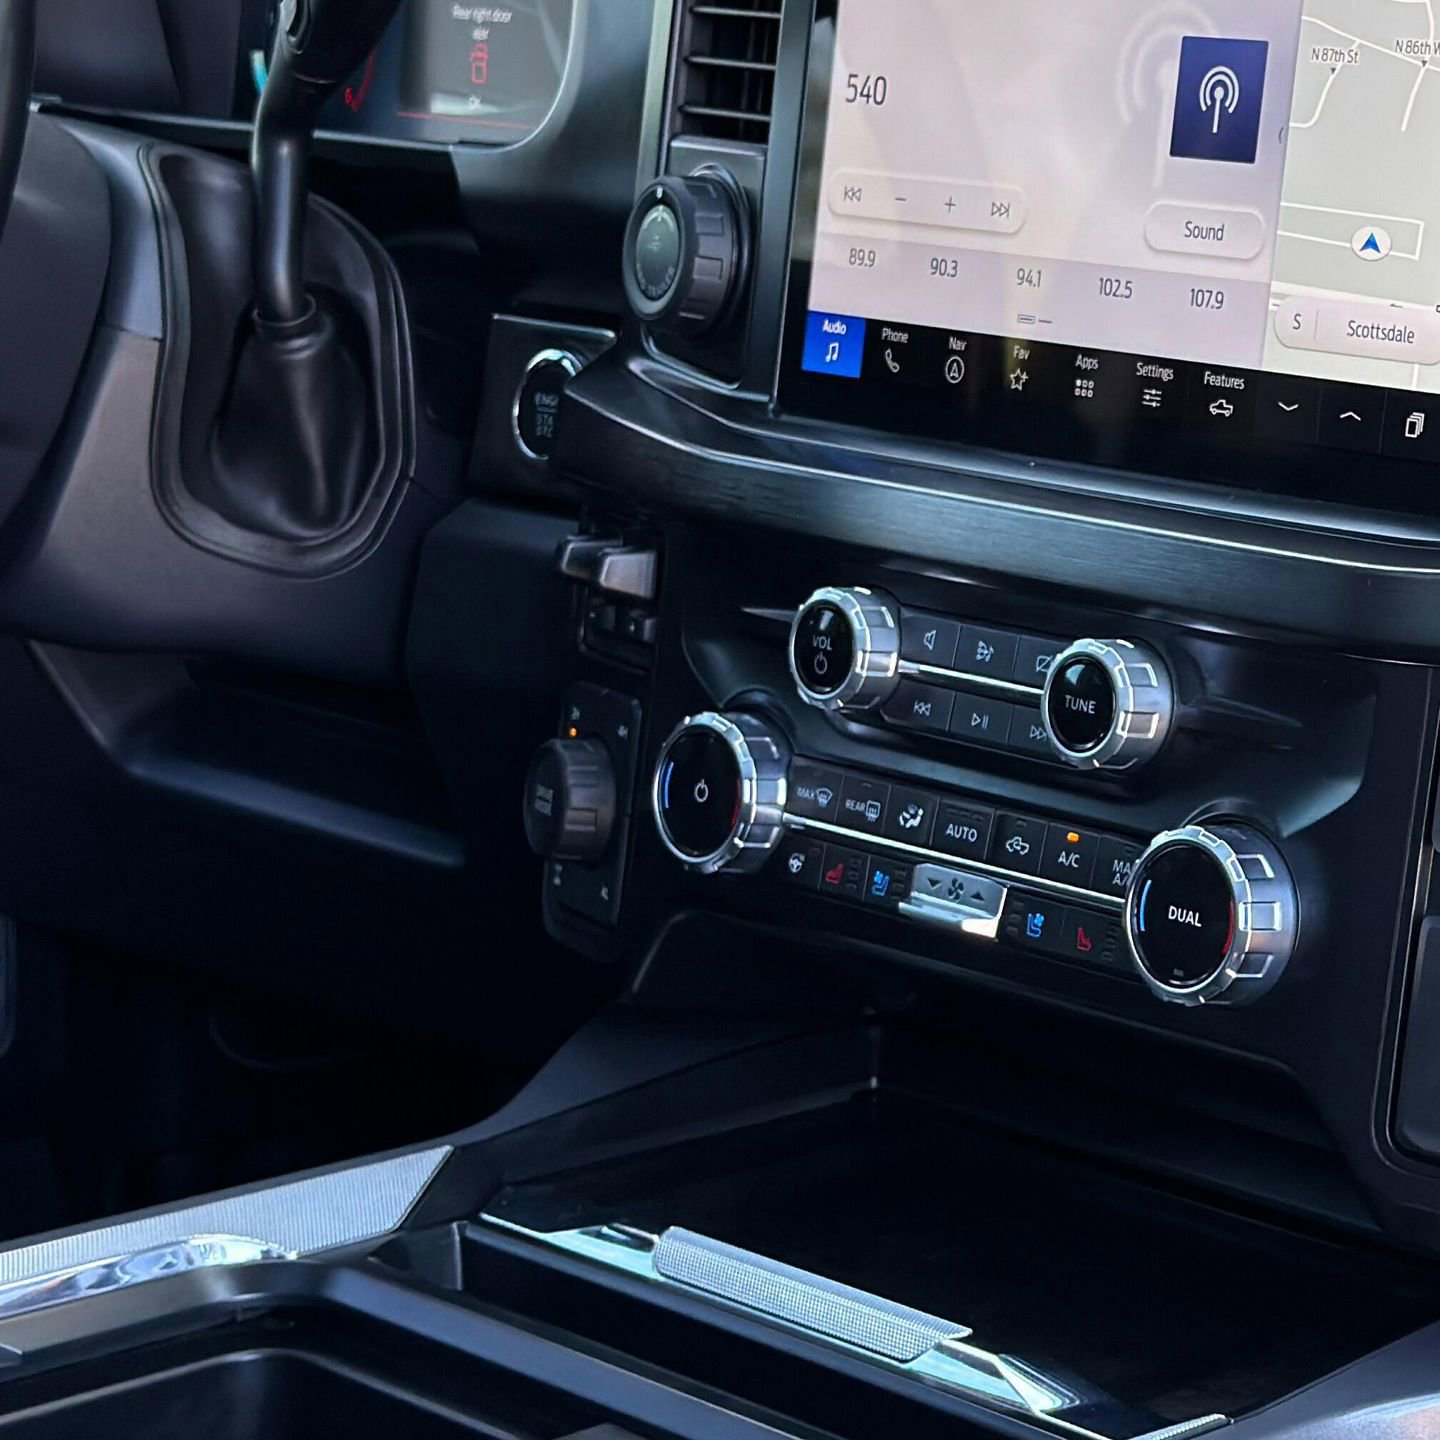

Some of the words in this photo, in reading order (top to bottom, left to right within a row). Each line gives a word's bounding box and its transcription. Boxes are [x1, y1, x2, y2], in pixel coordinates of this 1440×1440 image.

[1312, 47, 1319, 61] N
[1321, 48, 1345, 62] 87th
[1347, 50, 1358, 64] St
[1395, 40, 1403, 53] N
[1405, 40, 1431, 55] 86th
[845, 73, 887, 106] 540
[1184, 221, 1225, 242] Sound
[849, 248, 876, 267] 89.9
[930, 258, 958, 277] 90.3
[1017, 268, 1041, 289] 94.1
[1099, 277, 1133, 299] 102.5
[1189, 288, 1225, 310] 107.9
[1292, 313, 1302, 330] S
[1346, 320, 1415, 344] Scottsdale
[822, 319, 847, 336] Audio
[881, 327, 909, 344] Phone
[949, 337, 967, 351] Nav
[1013, 345, 1030, 360] Fav
[1075, 354, 1099, 371] Apps
[1136, 362, 1174, 381] Settings
[1204, 371, 1245, 390] Features
[812, 635, 833, 651] VOL
[1065, 695, 1096, 714] TUNE
[796, 787, 816, 800] MAX
[845, 799, 866, 812] REAR
[945, 823, 978, 842] AUTO
[1058, 851, 1080, 868] A/C
[1112, 860, 1131, 874] MA
[1168, 905, 1202, 928] DUAL
